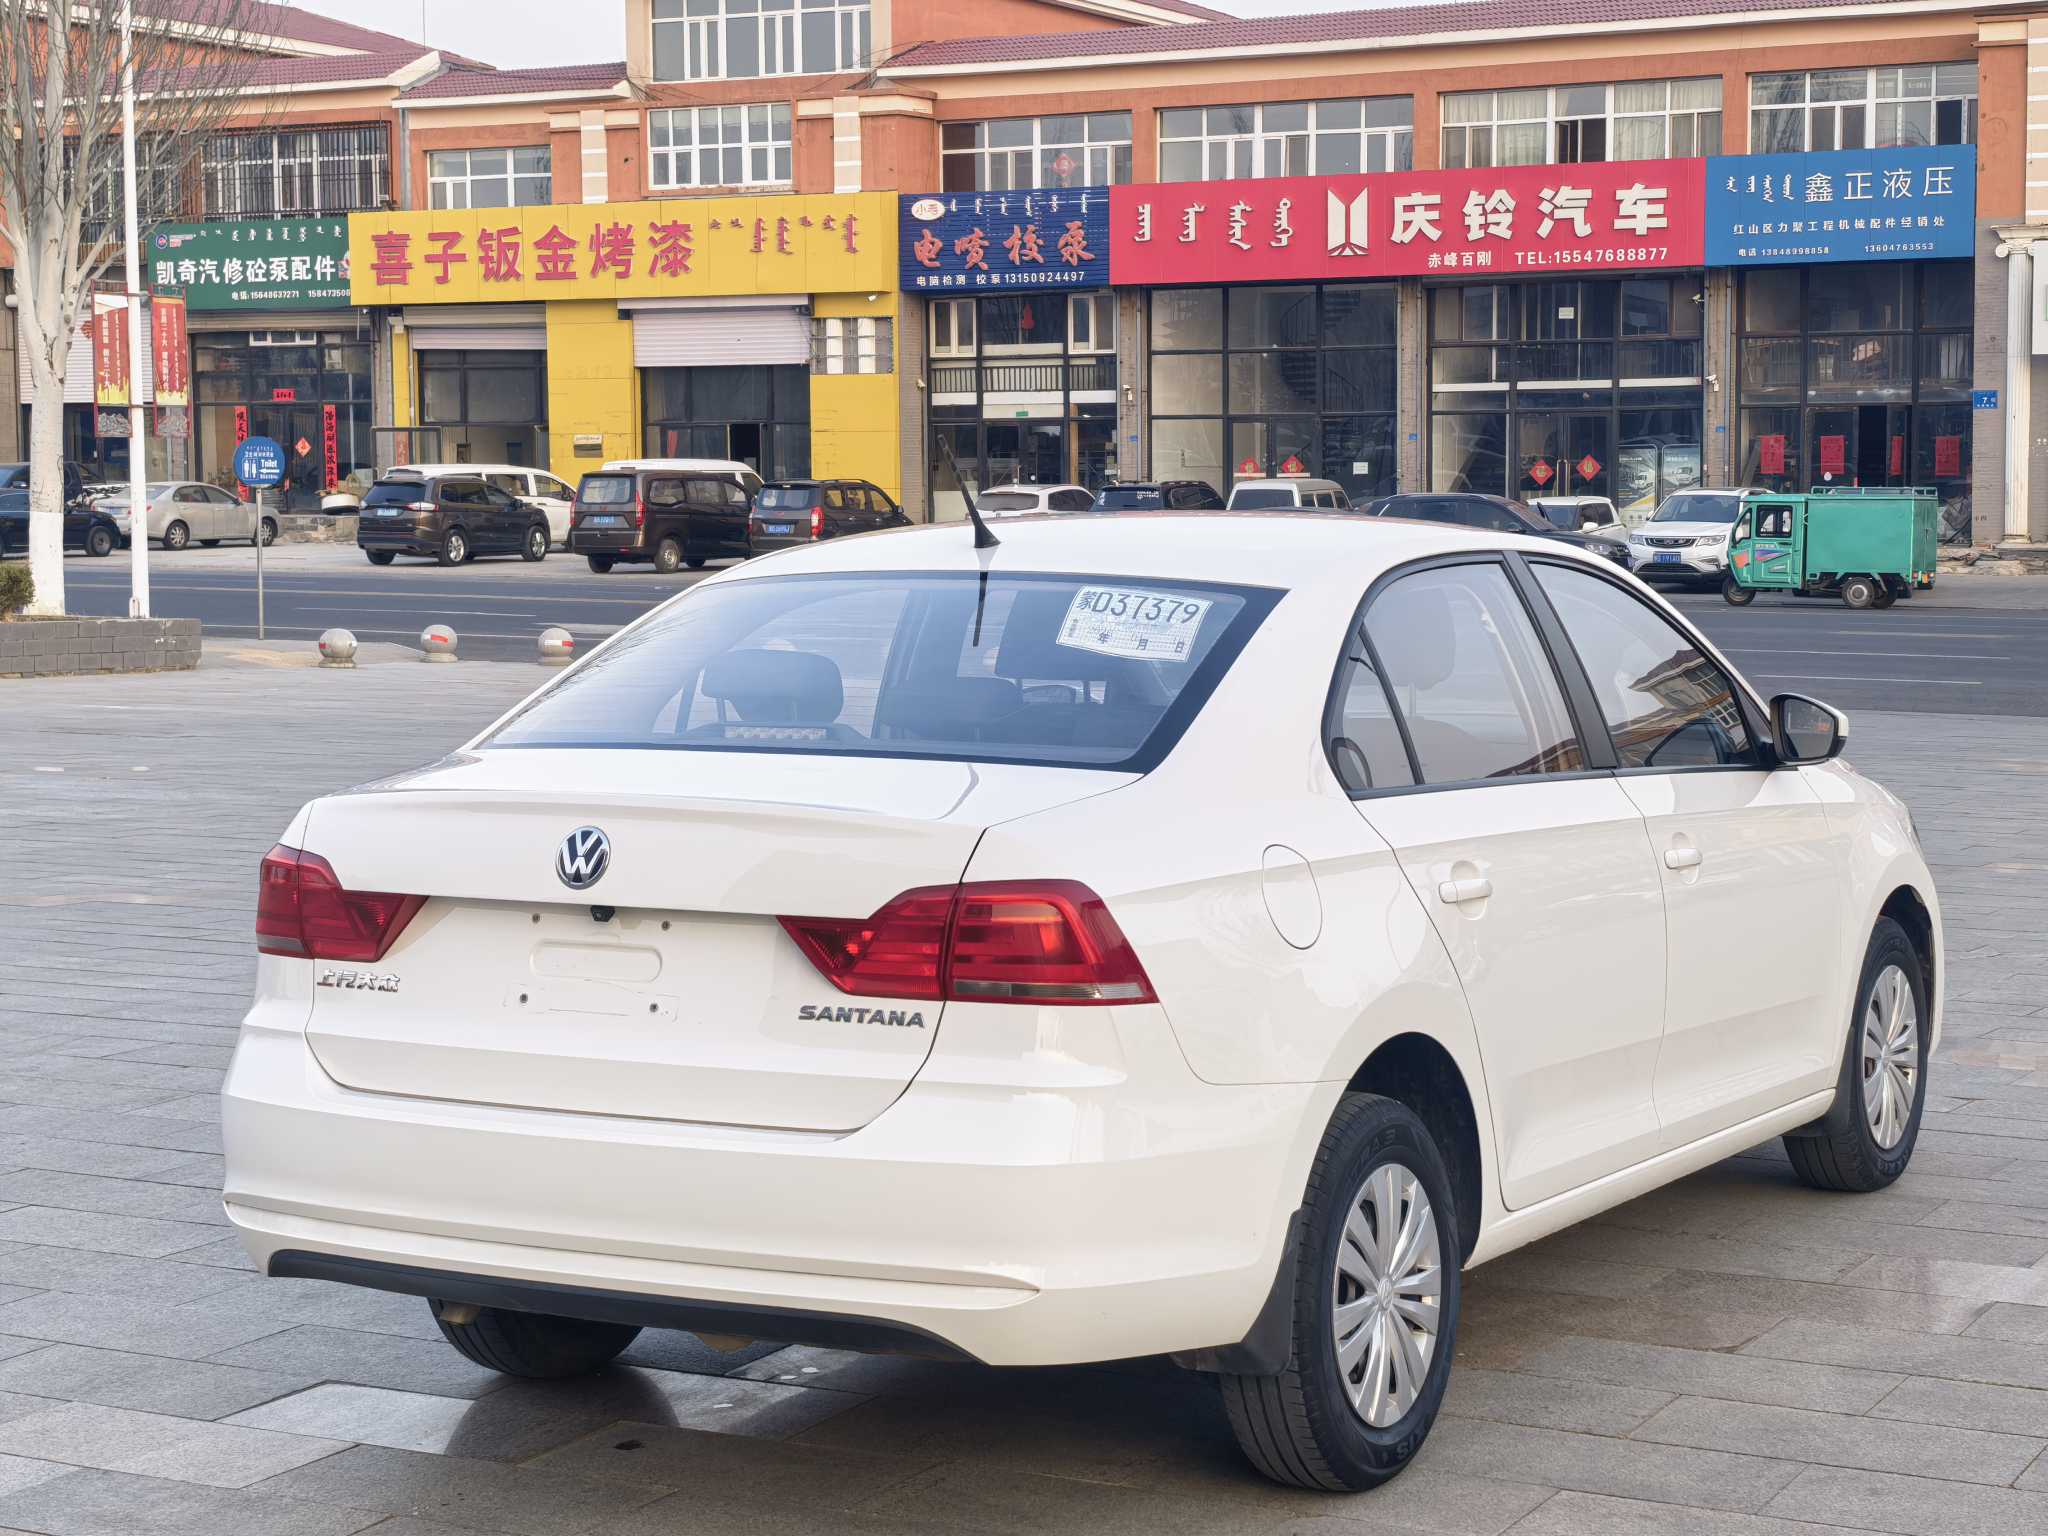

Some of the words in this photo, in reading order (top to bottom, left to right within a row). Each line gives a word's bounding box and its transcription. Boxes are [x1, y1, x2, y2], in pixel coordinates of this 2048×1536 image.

[1804, 165, 1956, 203] 鑫正液压
[1390, 182, 1668, 244] 庆铃汽车
[1733, 216, 1946, 235] 红山区力聚工程机械配件经销处
[370, 219, 695, 286] 喜子钣金烤漆
[913, 219, 1096, 271] 电喷校泵
[1427, 250, 1492, 268] 赤峰百刚
[156, 254, 336, 285] 凯奇汽修砼泵配件
[1076, 590, 1200, 624] 蒙D37379
[316, 967, 401, 993] 上汽大众
[798, 1004, 926, 1029] SANTANA
